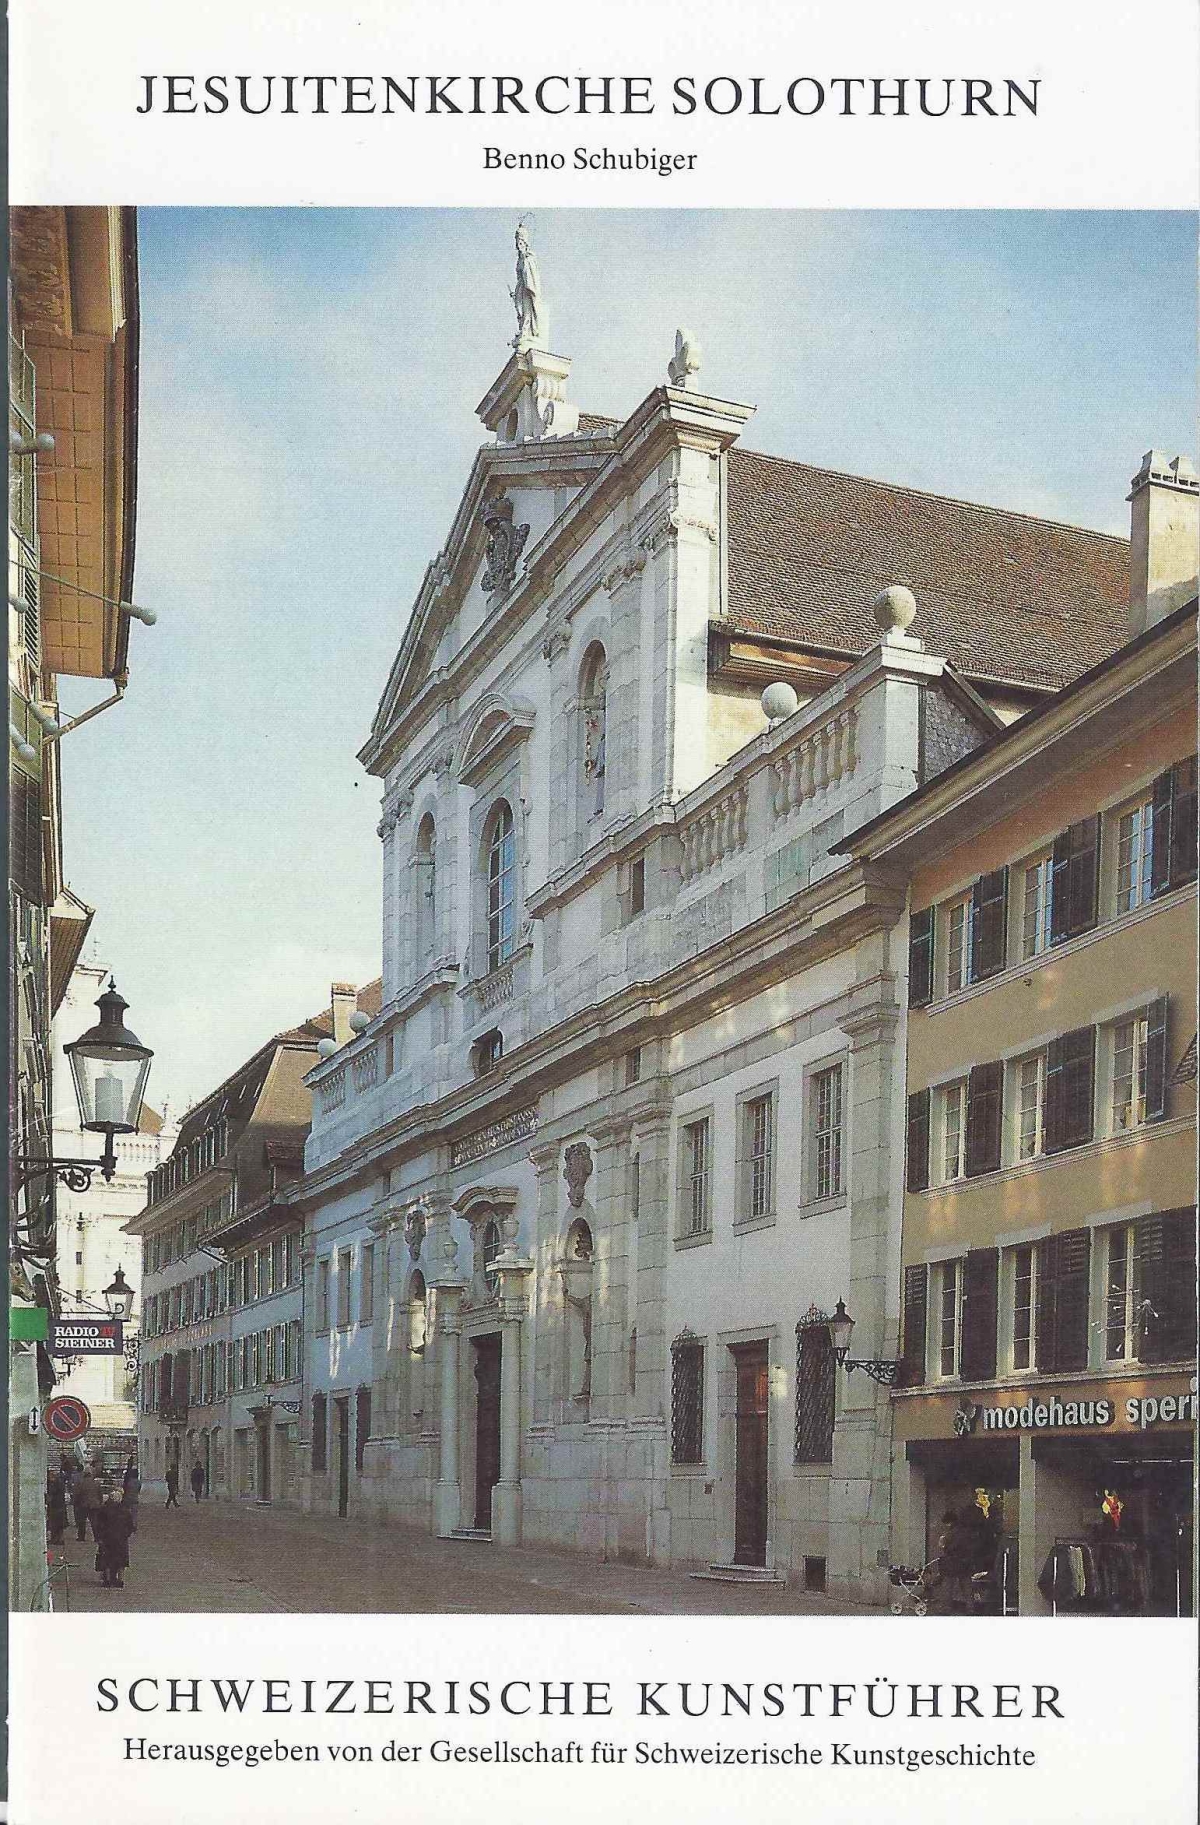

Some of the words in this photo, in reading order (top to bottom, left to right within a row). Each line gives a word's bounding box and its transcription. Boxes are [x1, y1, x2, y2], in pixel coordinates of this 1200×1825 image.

[136, 76, 655, 115] JESUITENKIRCHE
[673, 77, 1042, 117] SOLOTHURN
[483, 148, 565, 170] Benno
[573, 148, 698, 177] Schubiger
[54, 1326, 100, 1337] RADIO
[55, 1338, 115, 1348] STEINER
[983, 1396, 1110, 1430] modehaus
[96, 1678, 613, 1716] SCHWEIZERISCHE
[636, 1677, 1065, 1719] KUNSTFÜHRER
[123, 1738, 320, 1768] Herausgegeben
[327, 1745, 373, 1762] von
[381, 1739, 423, 1763] der
[430, 1740, 584, 1764] Gesellschaft
[591, 1741, 628, 1764] für
[635, 1741, 823, 1765] Schweizerische
[830, 1743, 1036, 1772] Kunstgeschichte
